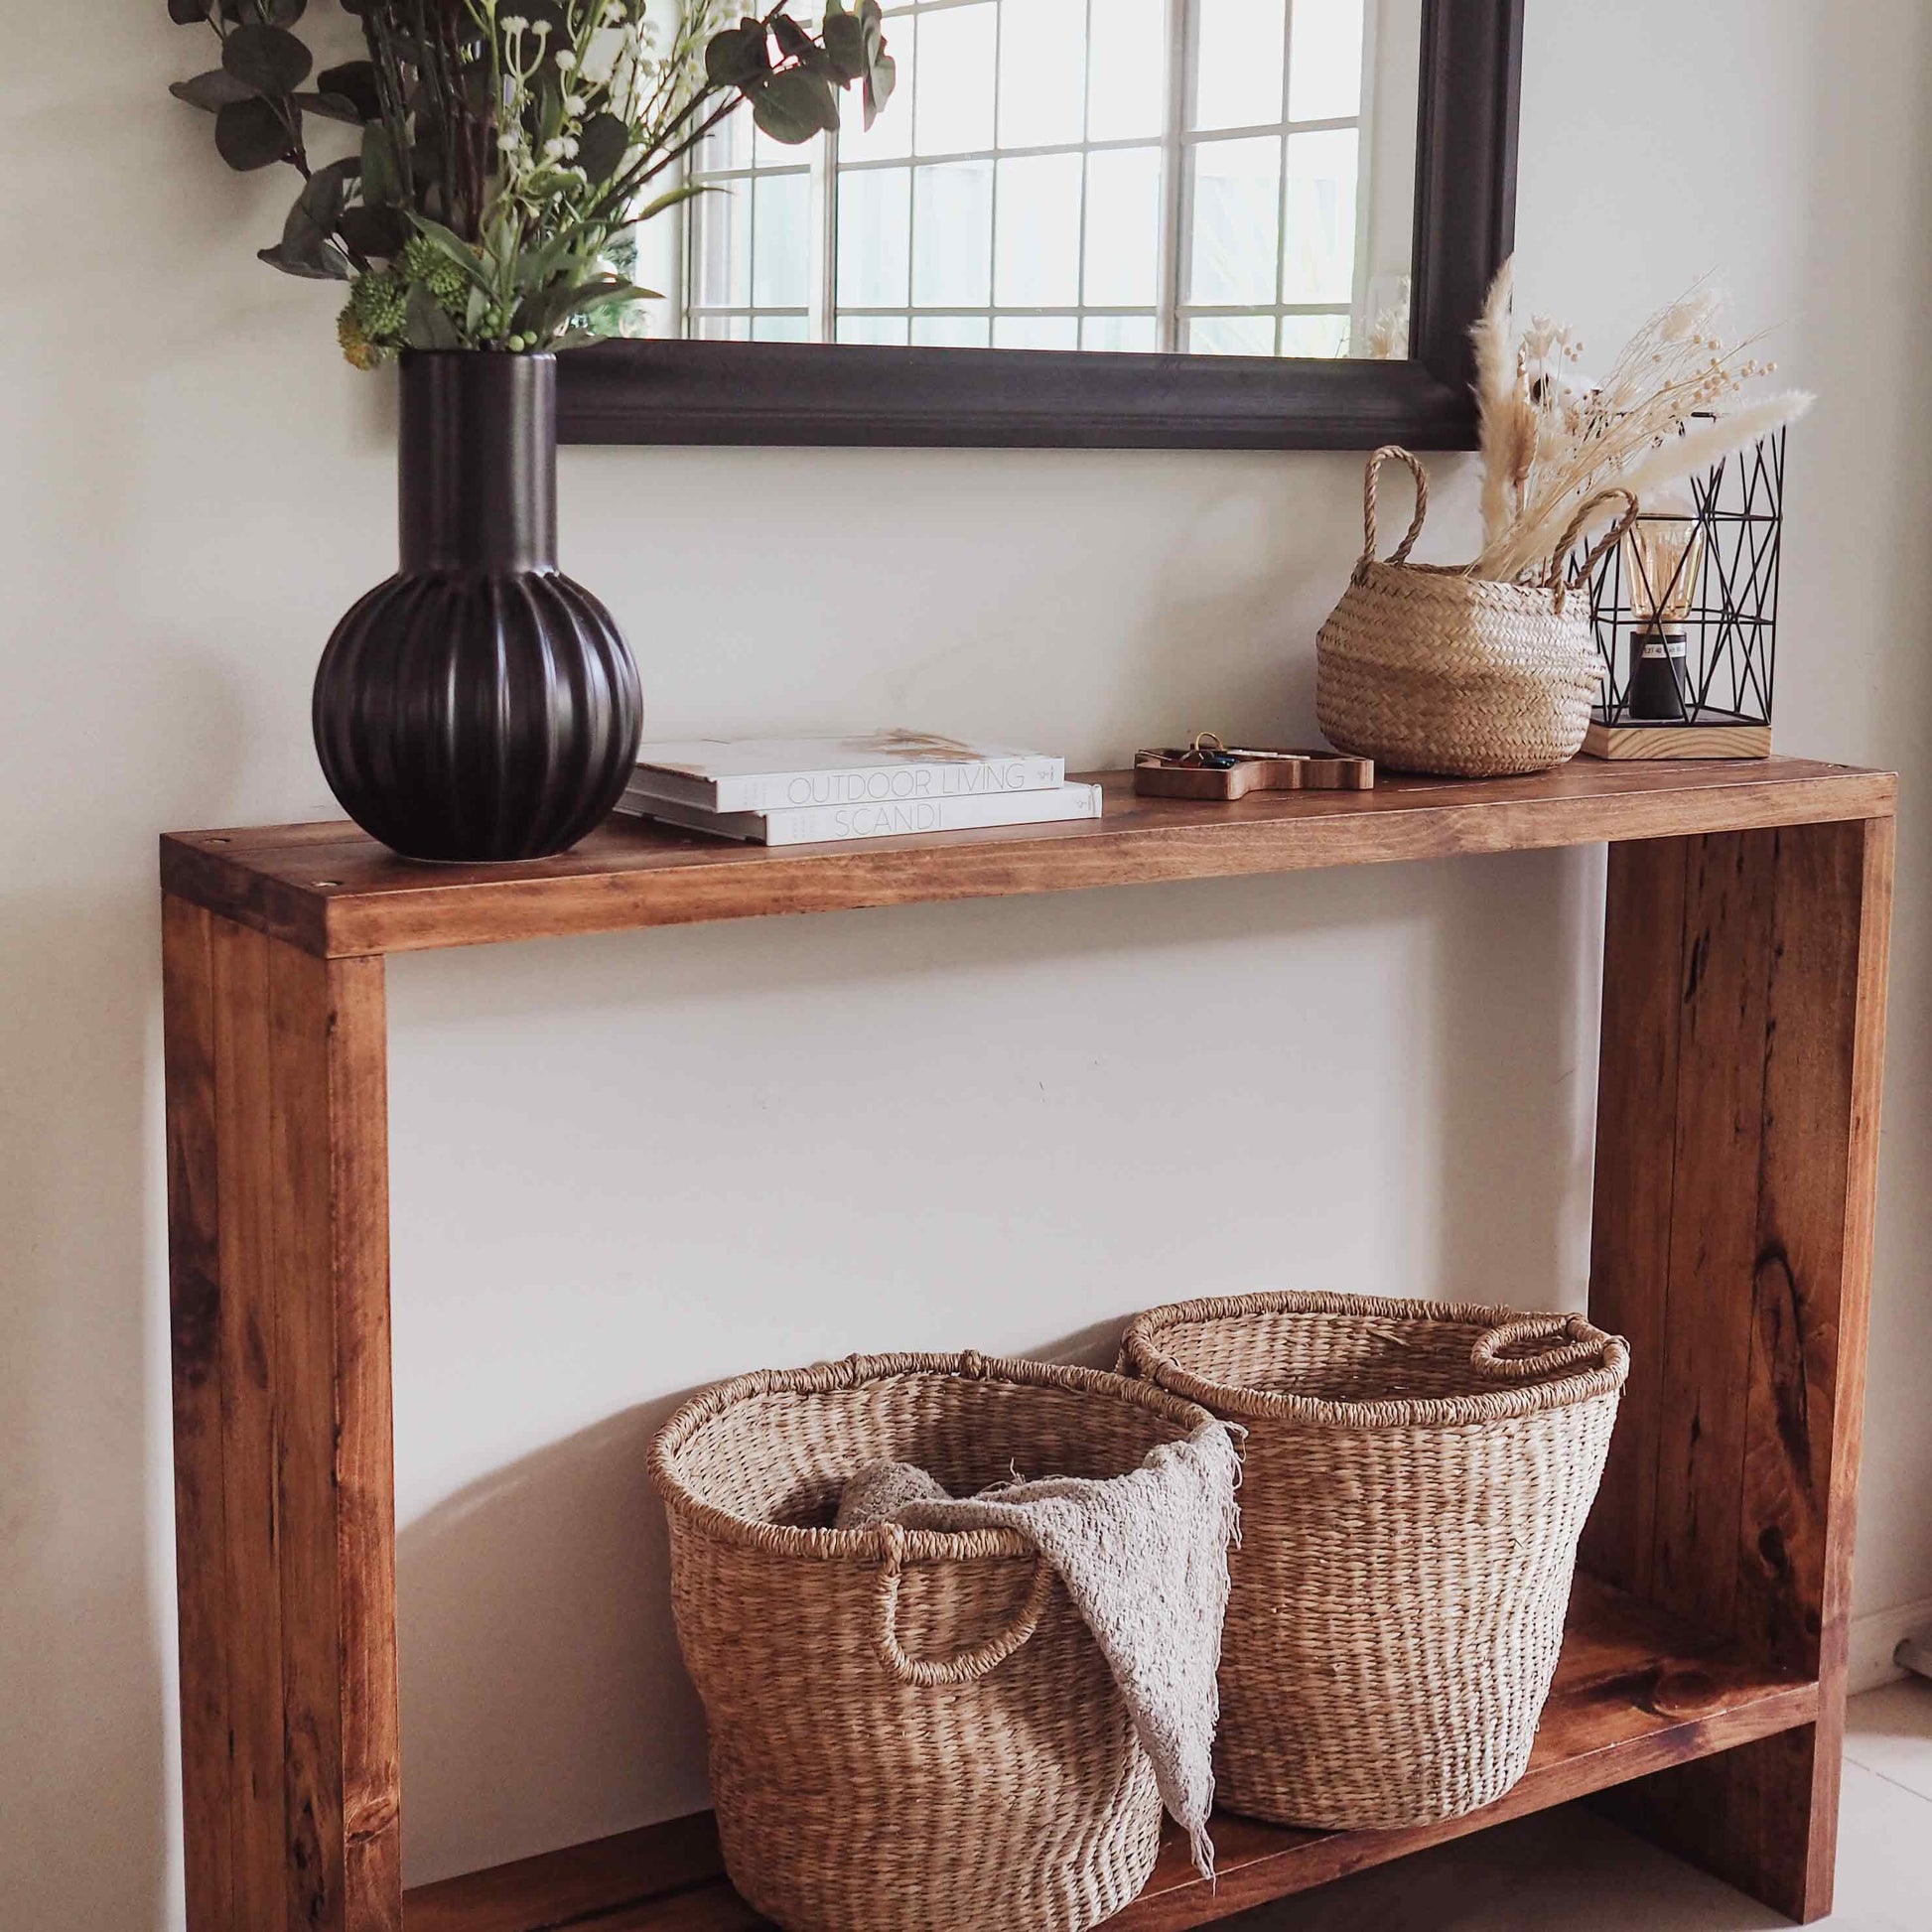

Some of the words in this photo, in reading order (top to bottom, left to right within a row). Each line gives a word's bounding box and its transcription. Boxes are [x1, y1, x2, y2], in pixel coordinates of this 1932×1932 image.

[787, 769, 931, 804] OUTDOOR
[942, 763, 1026, 794] LIVING
[835, 803, 942, 837] SCANDI
